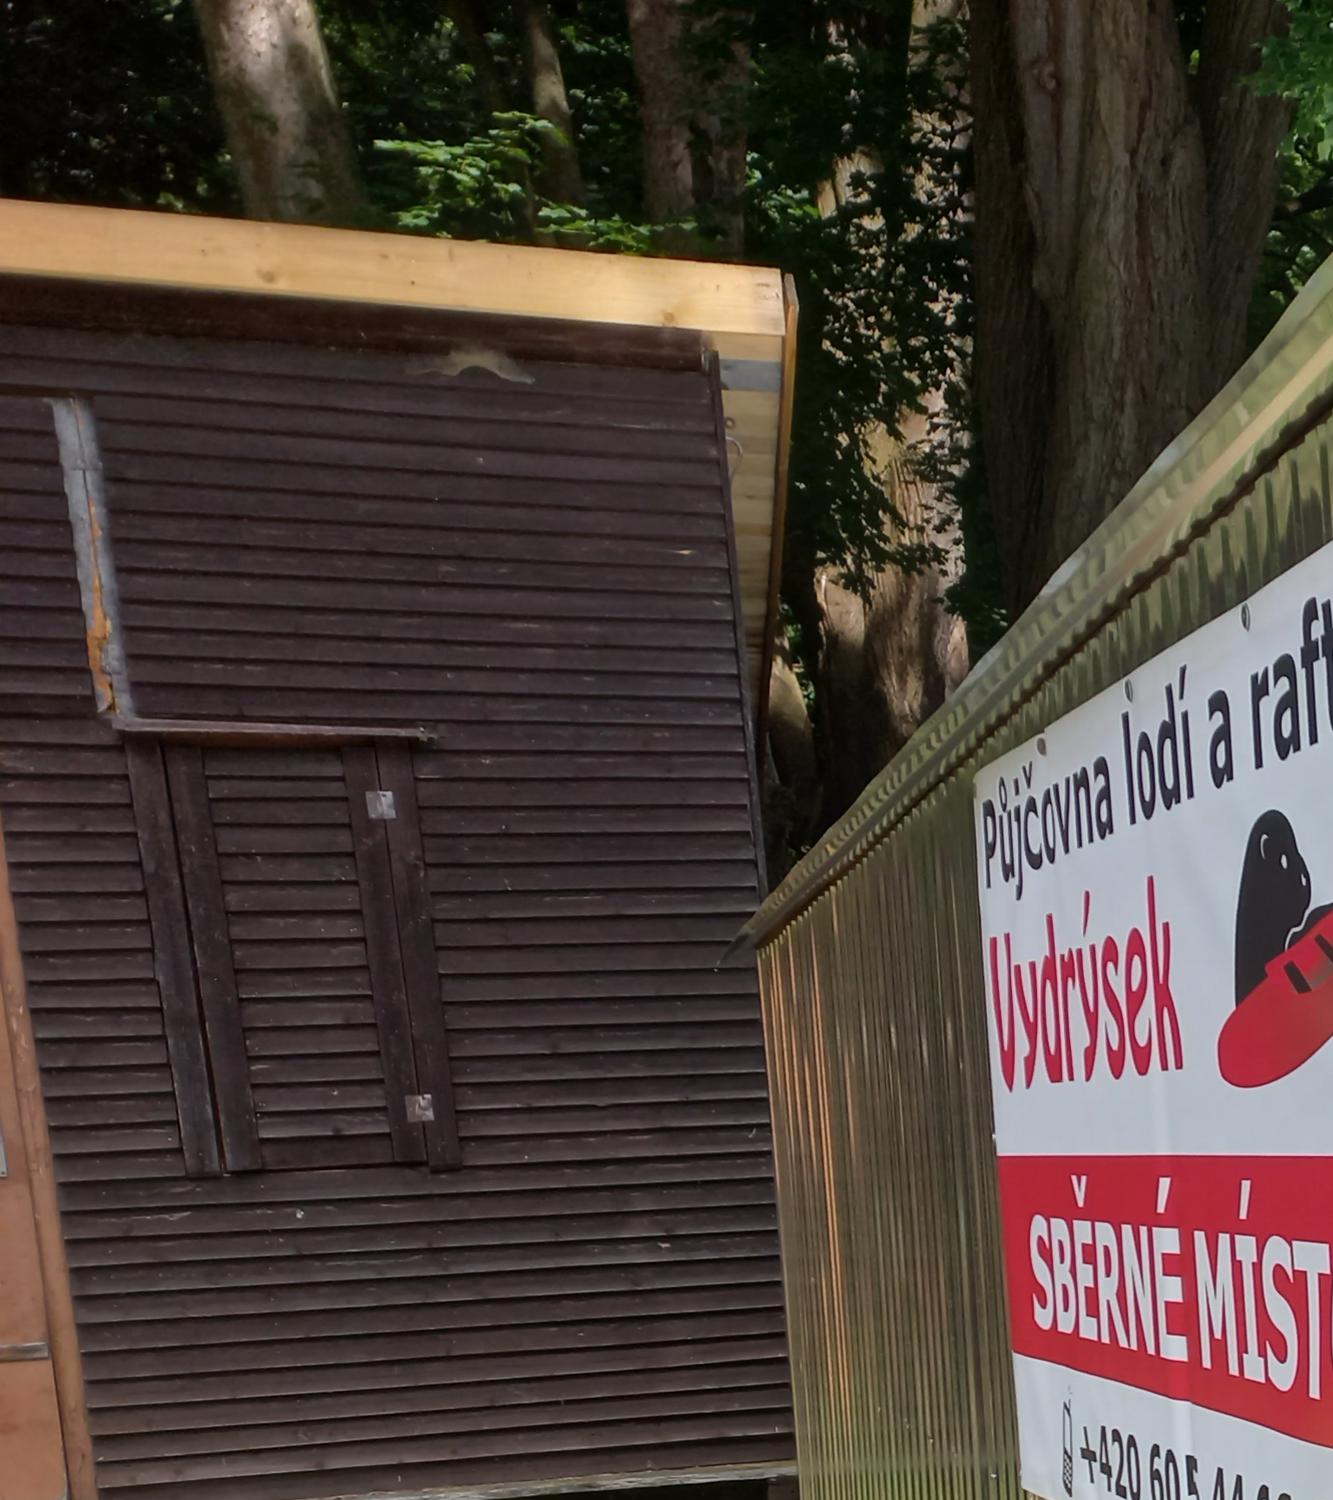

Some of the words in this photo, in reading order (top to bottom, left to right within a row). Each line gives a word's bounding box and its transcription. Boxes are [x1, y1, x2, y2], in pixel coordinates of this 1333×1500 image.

[981, 755, 1115, 901] Půjčovna
[1121, 665, 1196, 826] lodí
[1208, 689, 1235, 789] a
[989, 875, 1184, 1093] Vydrýsek
[1028, 1174, 1190, 1363] SBĚRNÉ
